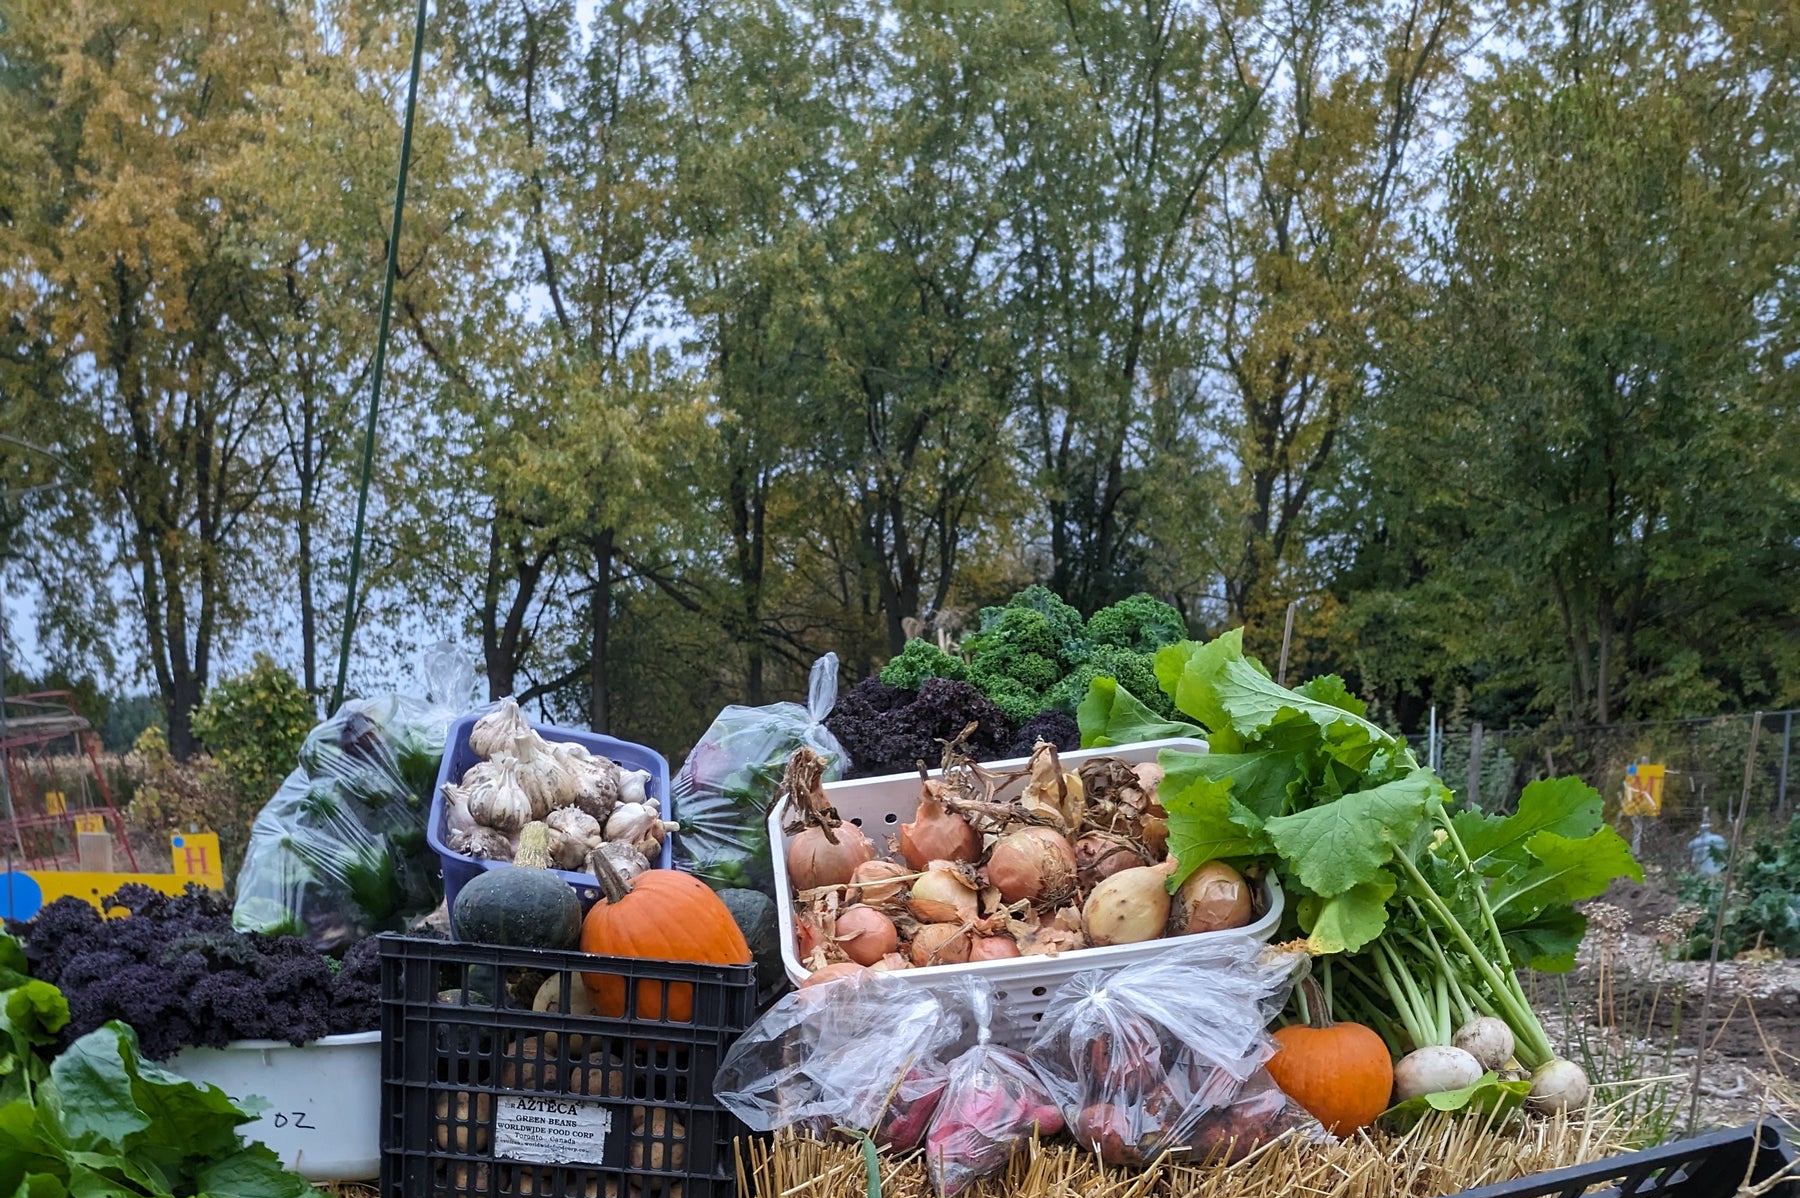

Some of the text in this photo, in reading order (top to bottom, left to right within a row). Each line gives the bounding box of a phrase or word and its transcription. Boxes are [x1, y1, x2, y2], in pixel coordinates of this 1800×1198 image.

[184, 847, 209, 875] H
[517, 1098, 578, 1115] AZTECA
[515, 1115, 577, 1128] GREEN BEANS
[515, 1132, 576, 1145] Toronto Canada
[548, 1128, 570, 1136] FOOD
[572, 1131, 594, 1139] CORP
